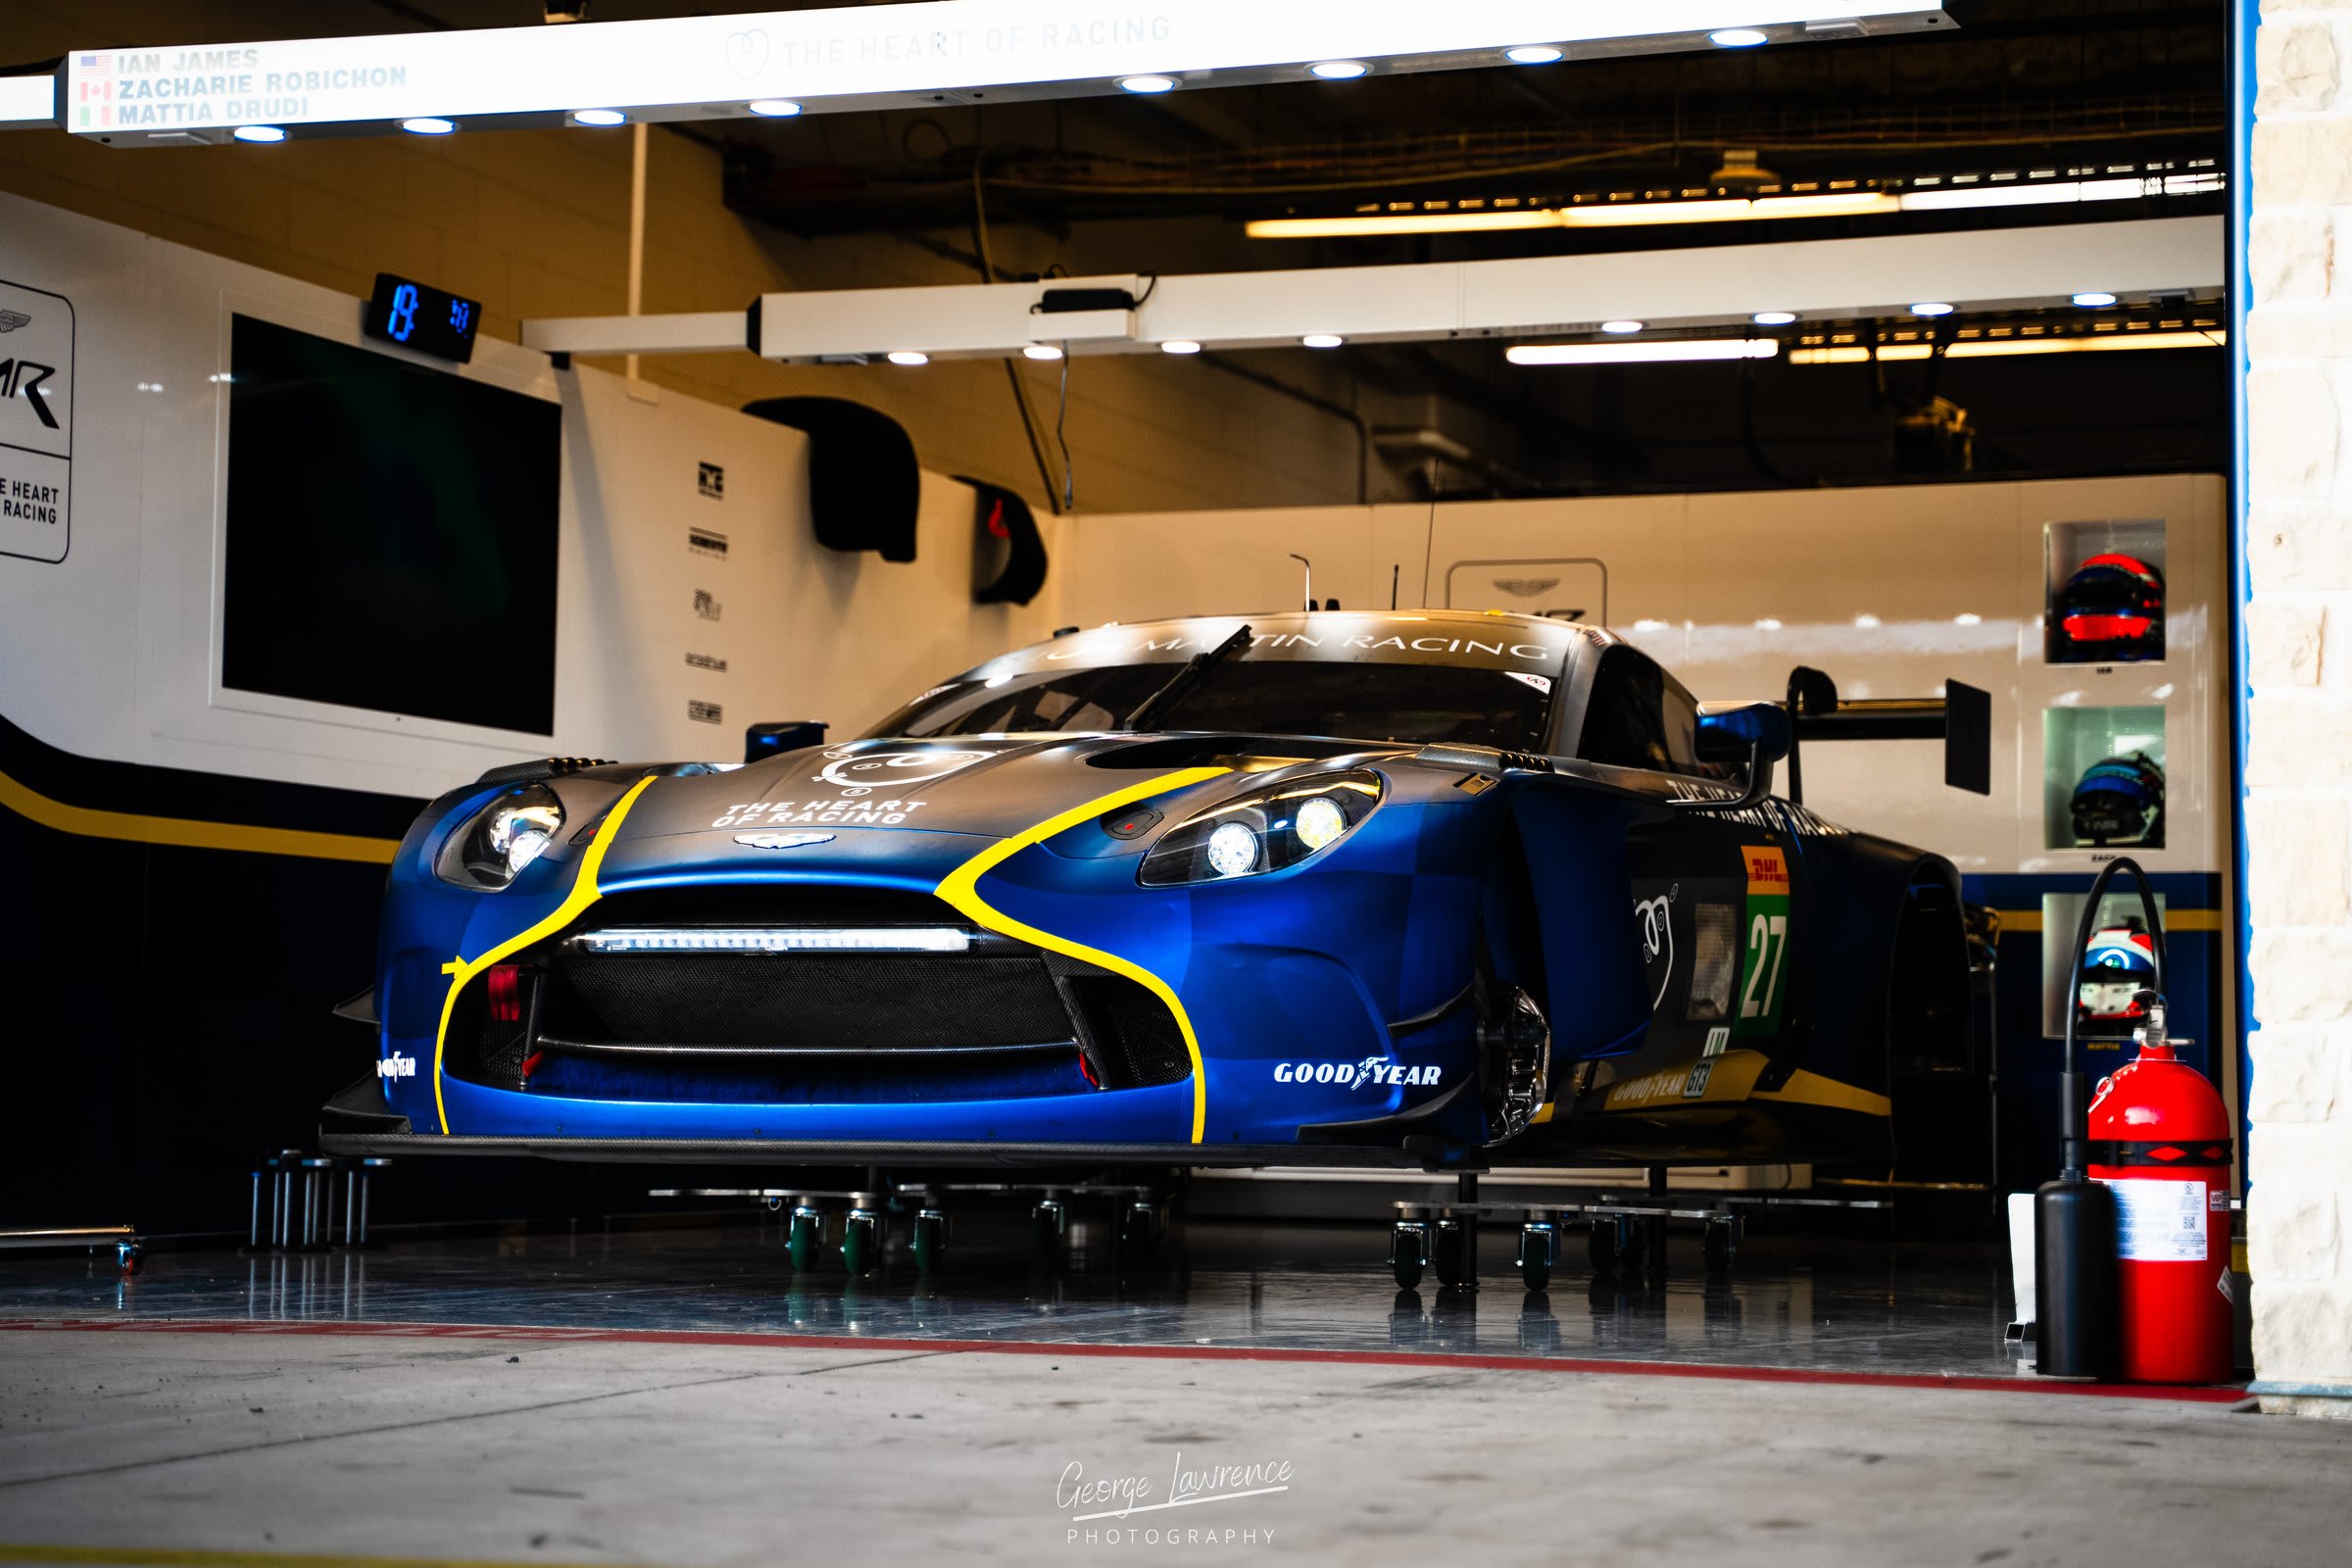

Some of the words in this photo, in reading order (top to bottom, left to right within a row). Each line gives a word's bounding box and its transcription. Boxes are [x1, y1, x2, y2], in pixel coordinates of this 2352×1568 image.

[782, 39, 845, 67] THE
[859, 30, 968, 60] HEART
[985, 24, 1027, 53] OF
[1042, 15, 1171, 49] RACING
[118, 53, 161, 74] IAN
[172, 48, 260, 73] JAMES
[119, 74, 252, 100] ZACHARIE
[266, 66, 408, 93] ROBICHON
[118, 102, 213, 124] MATTIA
[226, 98, 309, 121] DRUDI
[12, 480, 59, 504] HEART
[4, 500, 57, 524] RACING
[1340, 635, 1548, 660] RACING
[711, 813, 761, 828] OF
[766, 811, 906, 825] RACING
[725, 803, 796, 815] THE
[802, 800, 927, 812] HEART
[1749, 858, 1788, 882] DHL
[1740, 914, 1788, 1018] 27
[1686, 1063, 1712, 1094] GT3
